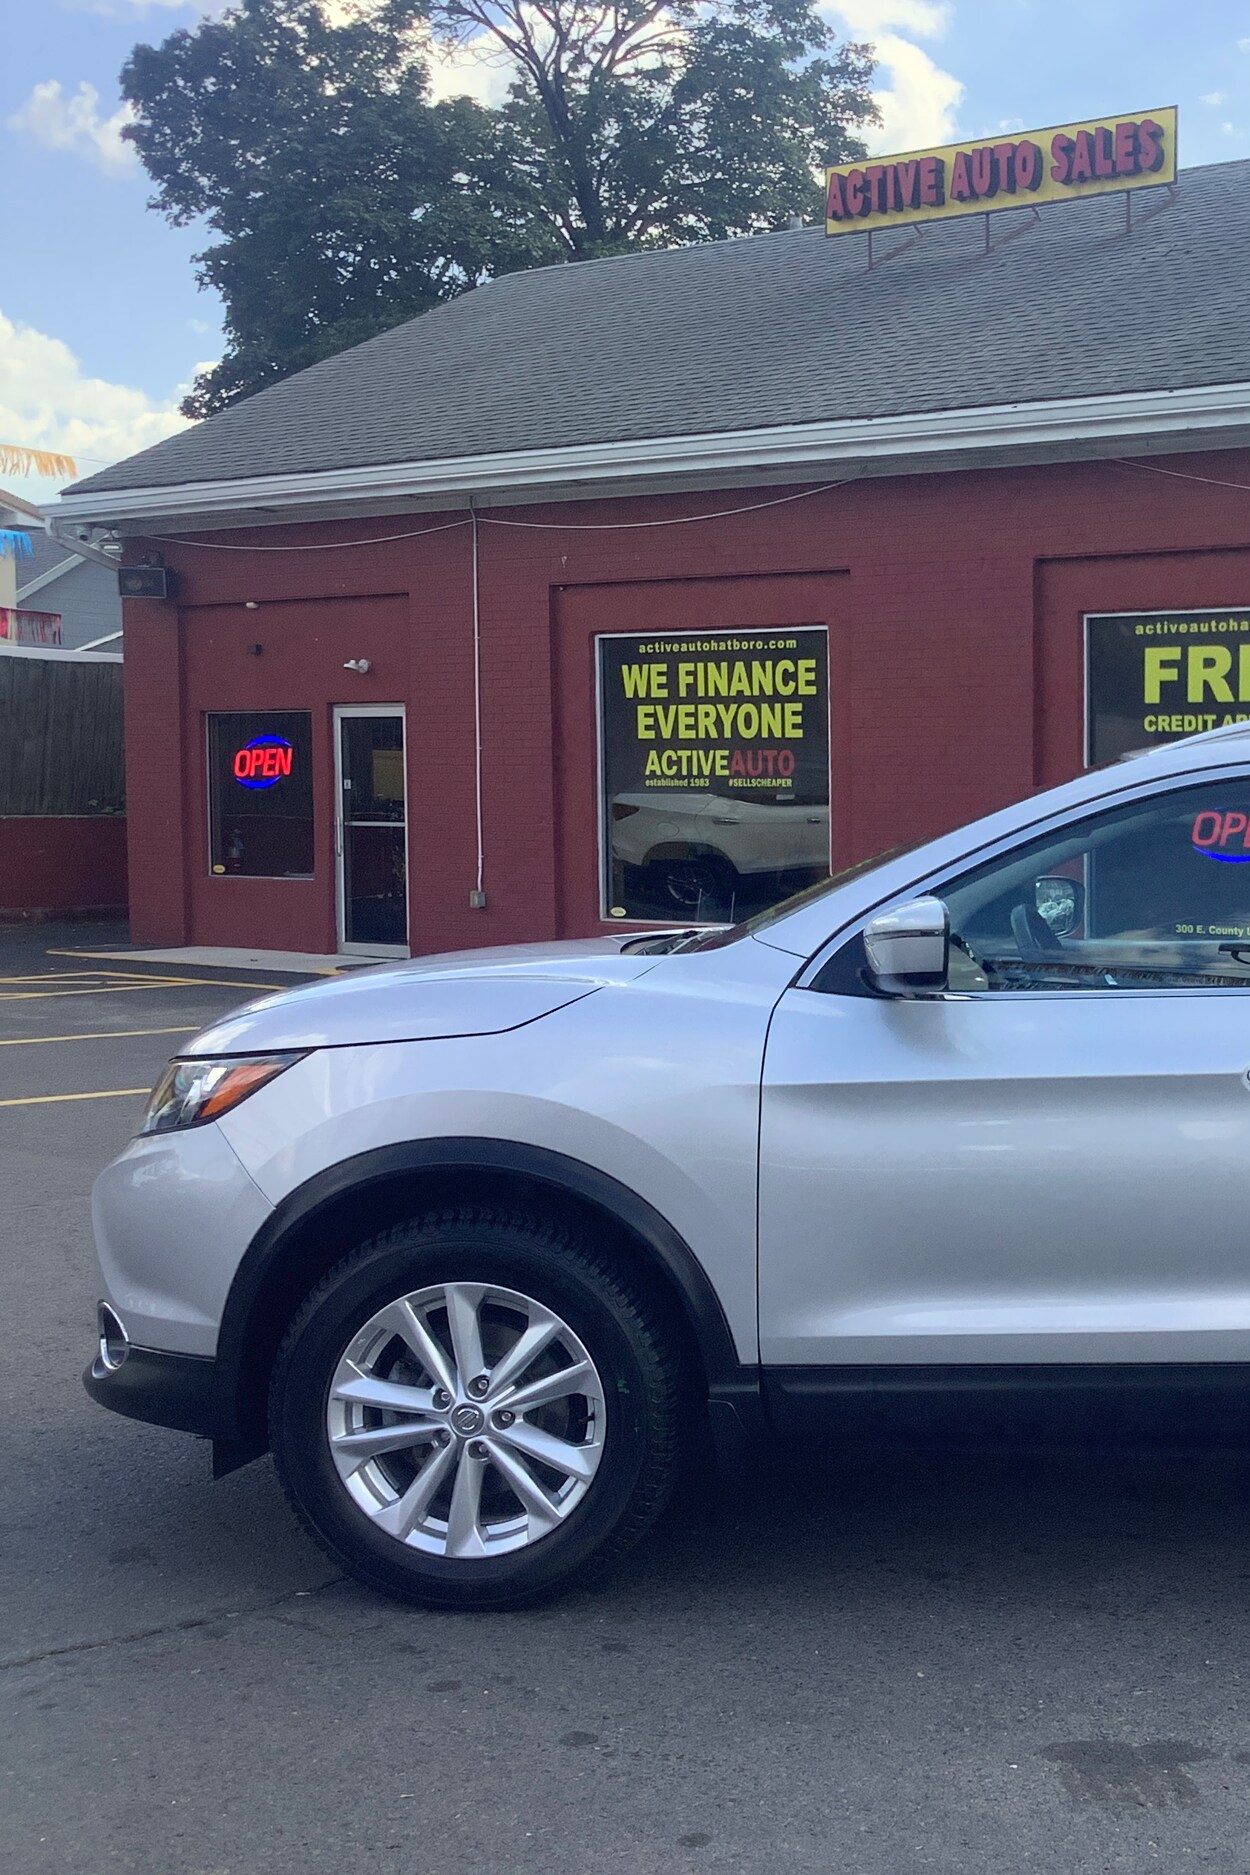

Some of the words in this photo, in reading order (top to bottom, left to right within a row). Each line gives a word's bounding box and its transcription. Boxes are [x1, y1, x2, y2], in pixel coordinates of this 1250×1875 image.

[827, 156, 945, 220] ACTIVE
[950, 139, 1043, 202] AUTO
[1050, 119, 1165, 184] SALES
[638, 638, 797, 654] activeautohatboro.com
[622, 663, 668, 698] WE
[678, 659, 817, 697] FINANCE
[637, 703, 803, 739] EVERYONE
[1143, 714, 1217, 732] CREDIT
[234, 748, 292, 778] OPEN
[645, 778, 688, 787] established
[690, 777, 710, 787] 1983
[728, 778, 792, 788] #SELLSCHEAPER
[1175, 924, 1194, 934] 300
[1196, 925, 1206, 934] E.
[1208, 925, 1244, 937] County
